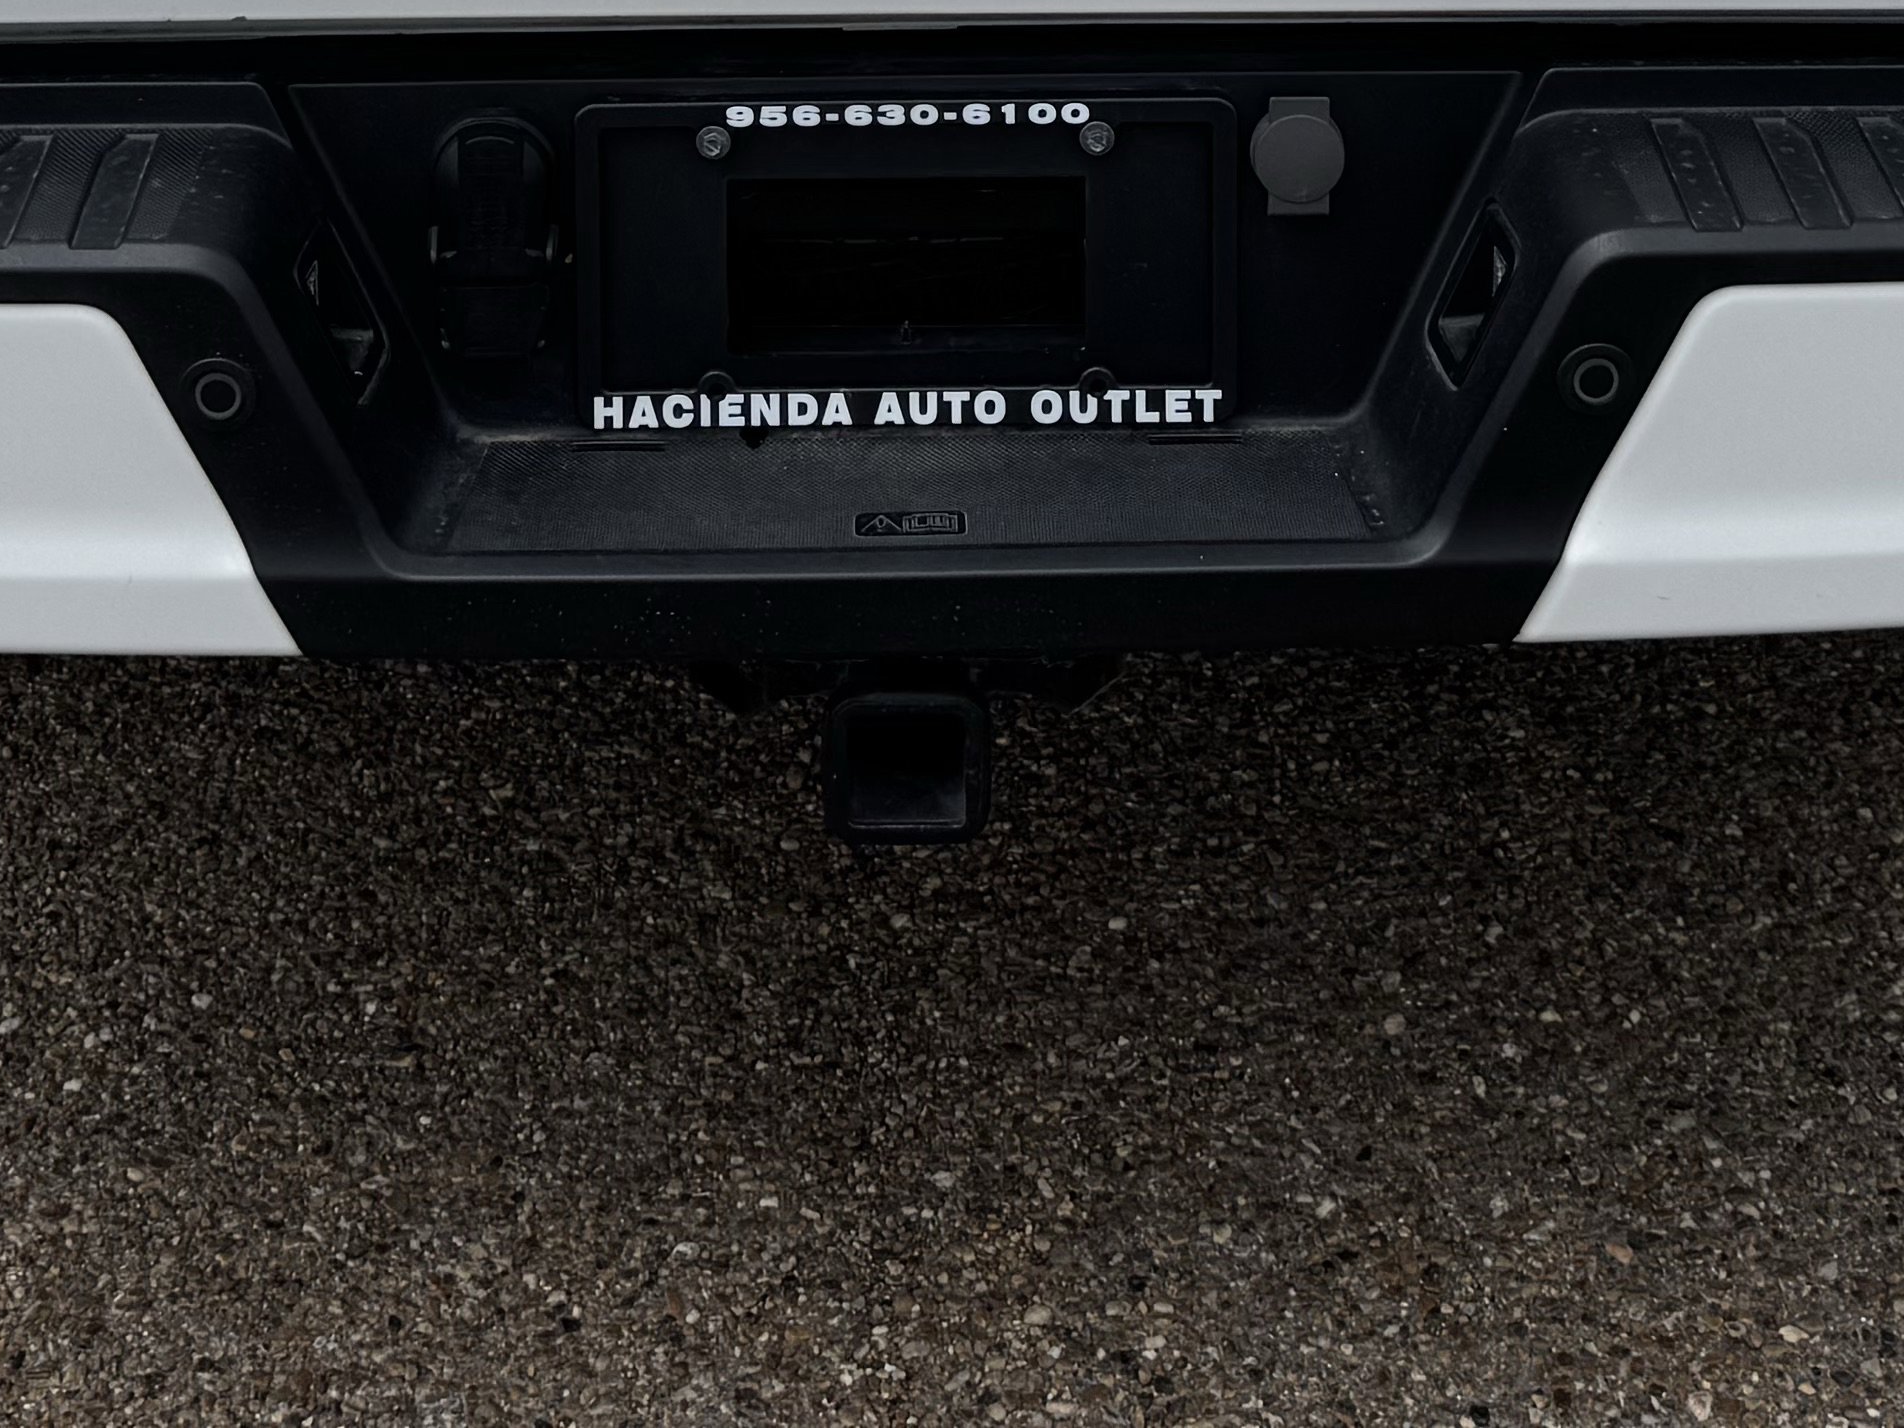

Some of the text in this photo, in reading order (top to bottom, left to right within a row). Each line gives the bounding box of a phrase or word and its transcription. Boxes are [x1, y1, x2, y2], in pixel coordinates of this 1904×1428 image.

[725, 102, 1090, 128] 956-630-6100
[593, 389, 1222, 429] HACIENDA AUTO OUTLET
